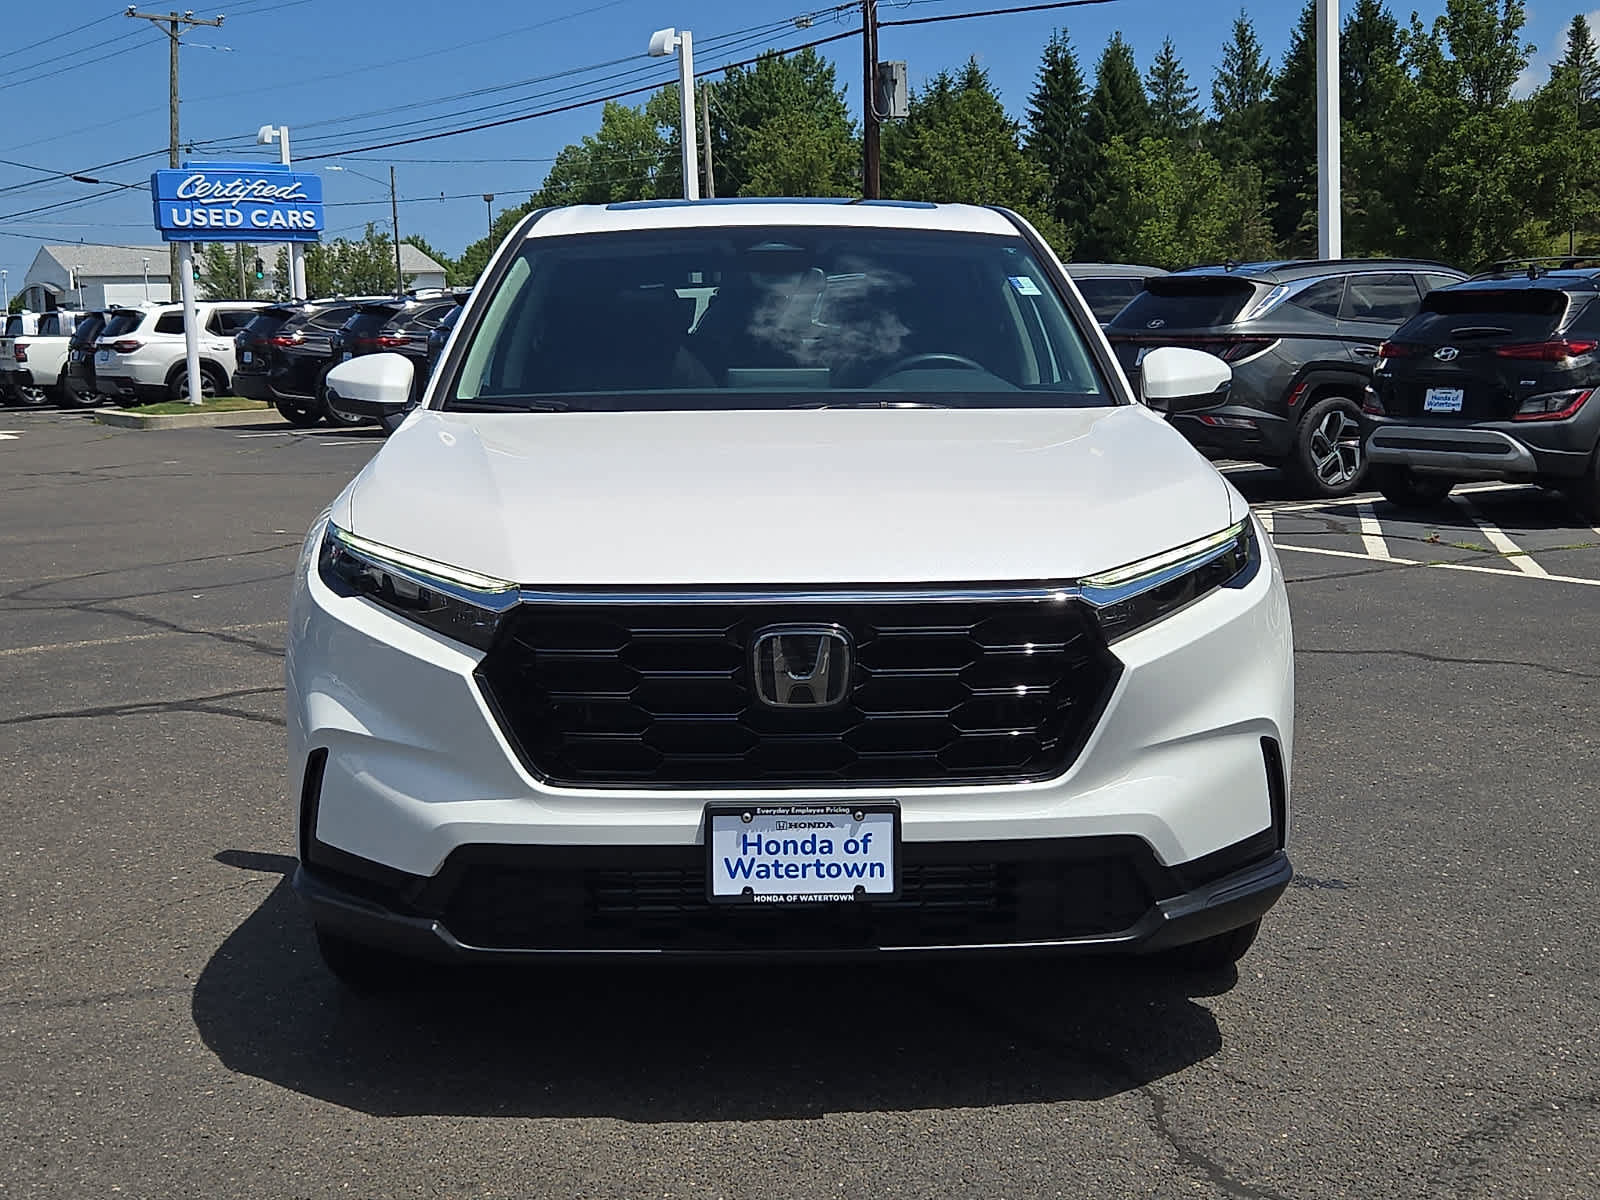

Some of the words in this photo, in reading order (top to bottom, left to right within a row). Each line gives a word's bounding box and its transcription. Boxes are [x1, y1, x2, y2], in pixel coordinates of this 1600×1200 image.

[177, 174, 307, 207] Certified
[172, 208, 243, 227] USED
[251, 209, 316, 228] CARS
[756, 807, 789, 815] Everyday
[825, 806, 850, 814] Pricing
[788, 821, 835, 829] HONDA
[742, 833, 833, 856] Honda
[843, 833, 873, 854] of
[724, 857, 885, 879] Watertown
[799, 894, 855, 902] WATERTOWN
